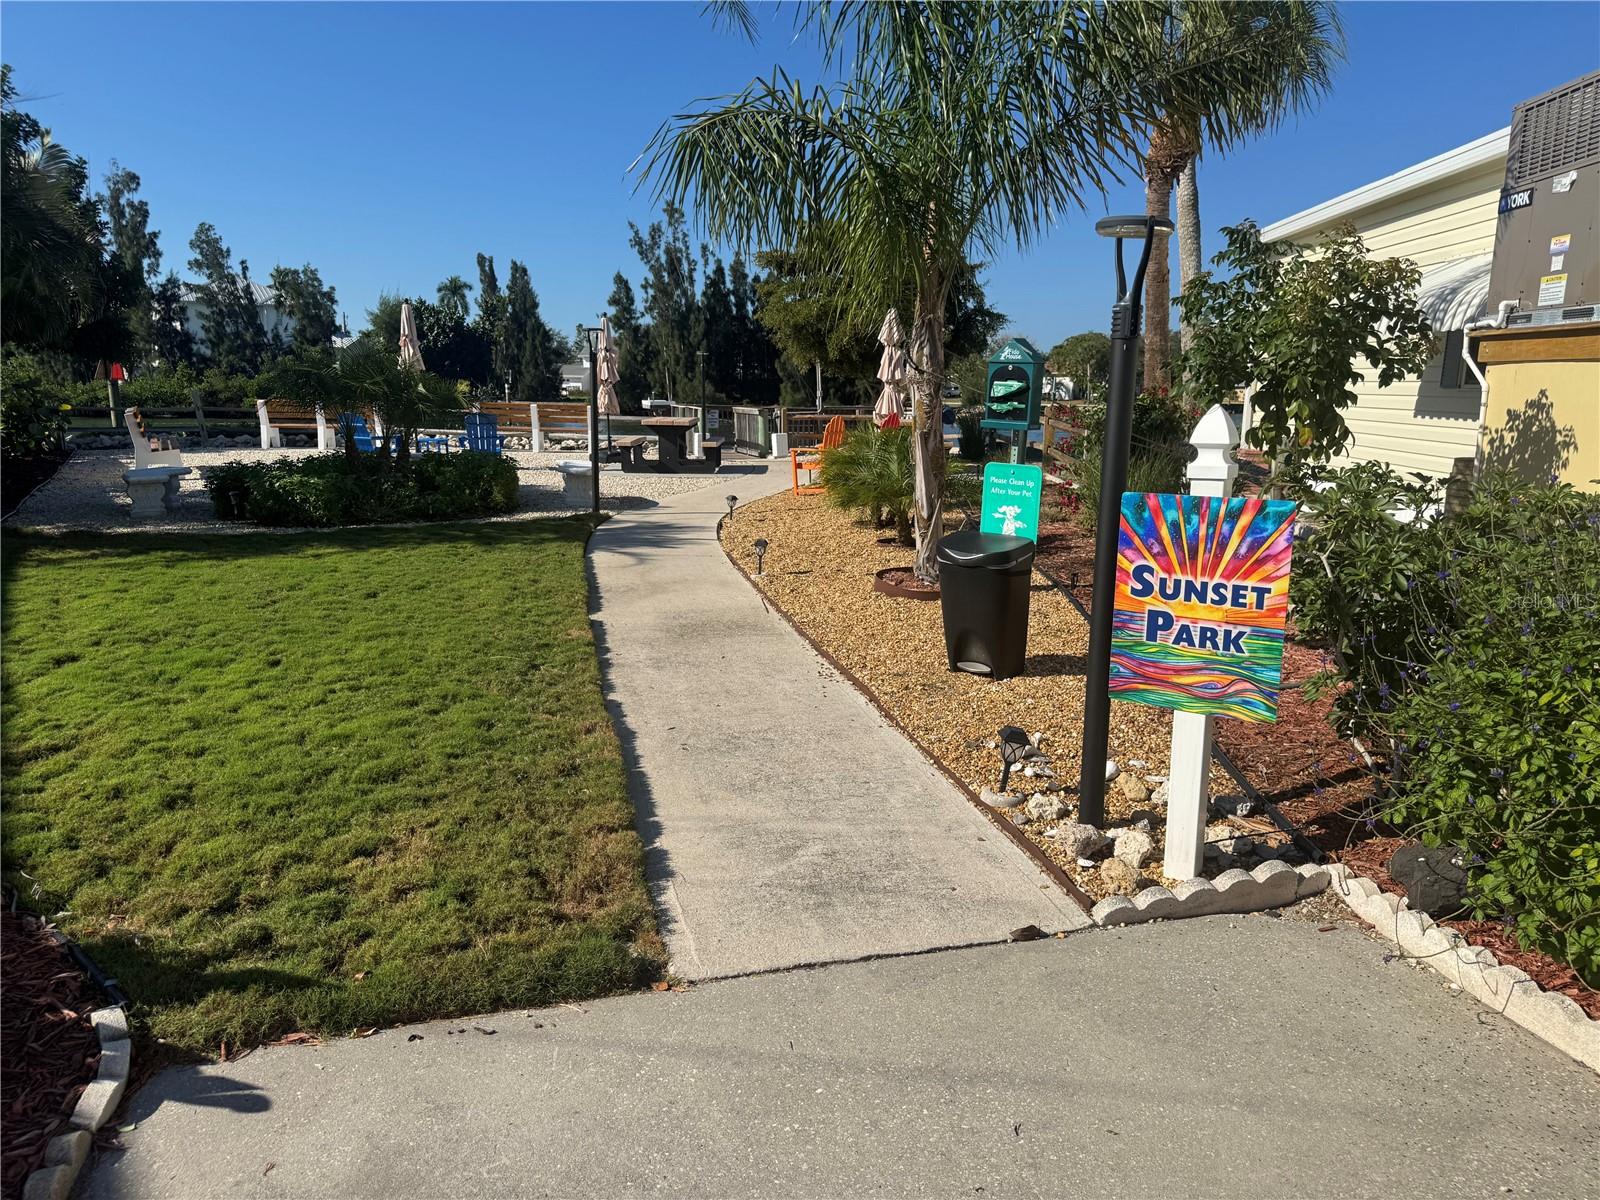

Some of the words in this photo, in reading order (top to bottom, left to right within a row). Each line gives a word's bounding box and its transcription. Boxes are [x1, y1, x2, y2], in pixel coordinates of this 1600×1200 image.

[1507, 190, 1531, 209] YORK
[990, 476, 1007, 485] Please
[1009, 477, 1024, 486] Clean
[1026, 479, 1035, 489] Up
[991, 487, 1006, 495] After
[1007, 488, 1021, 496] Your
[1022, 490, 1032, 498] Pet
[1130, 564, 1272, 611] SUNSET
[1145, 609, 1248, 655] PARK
